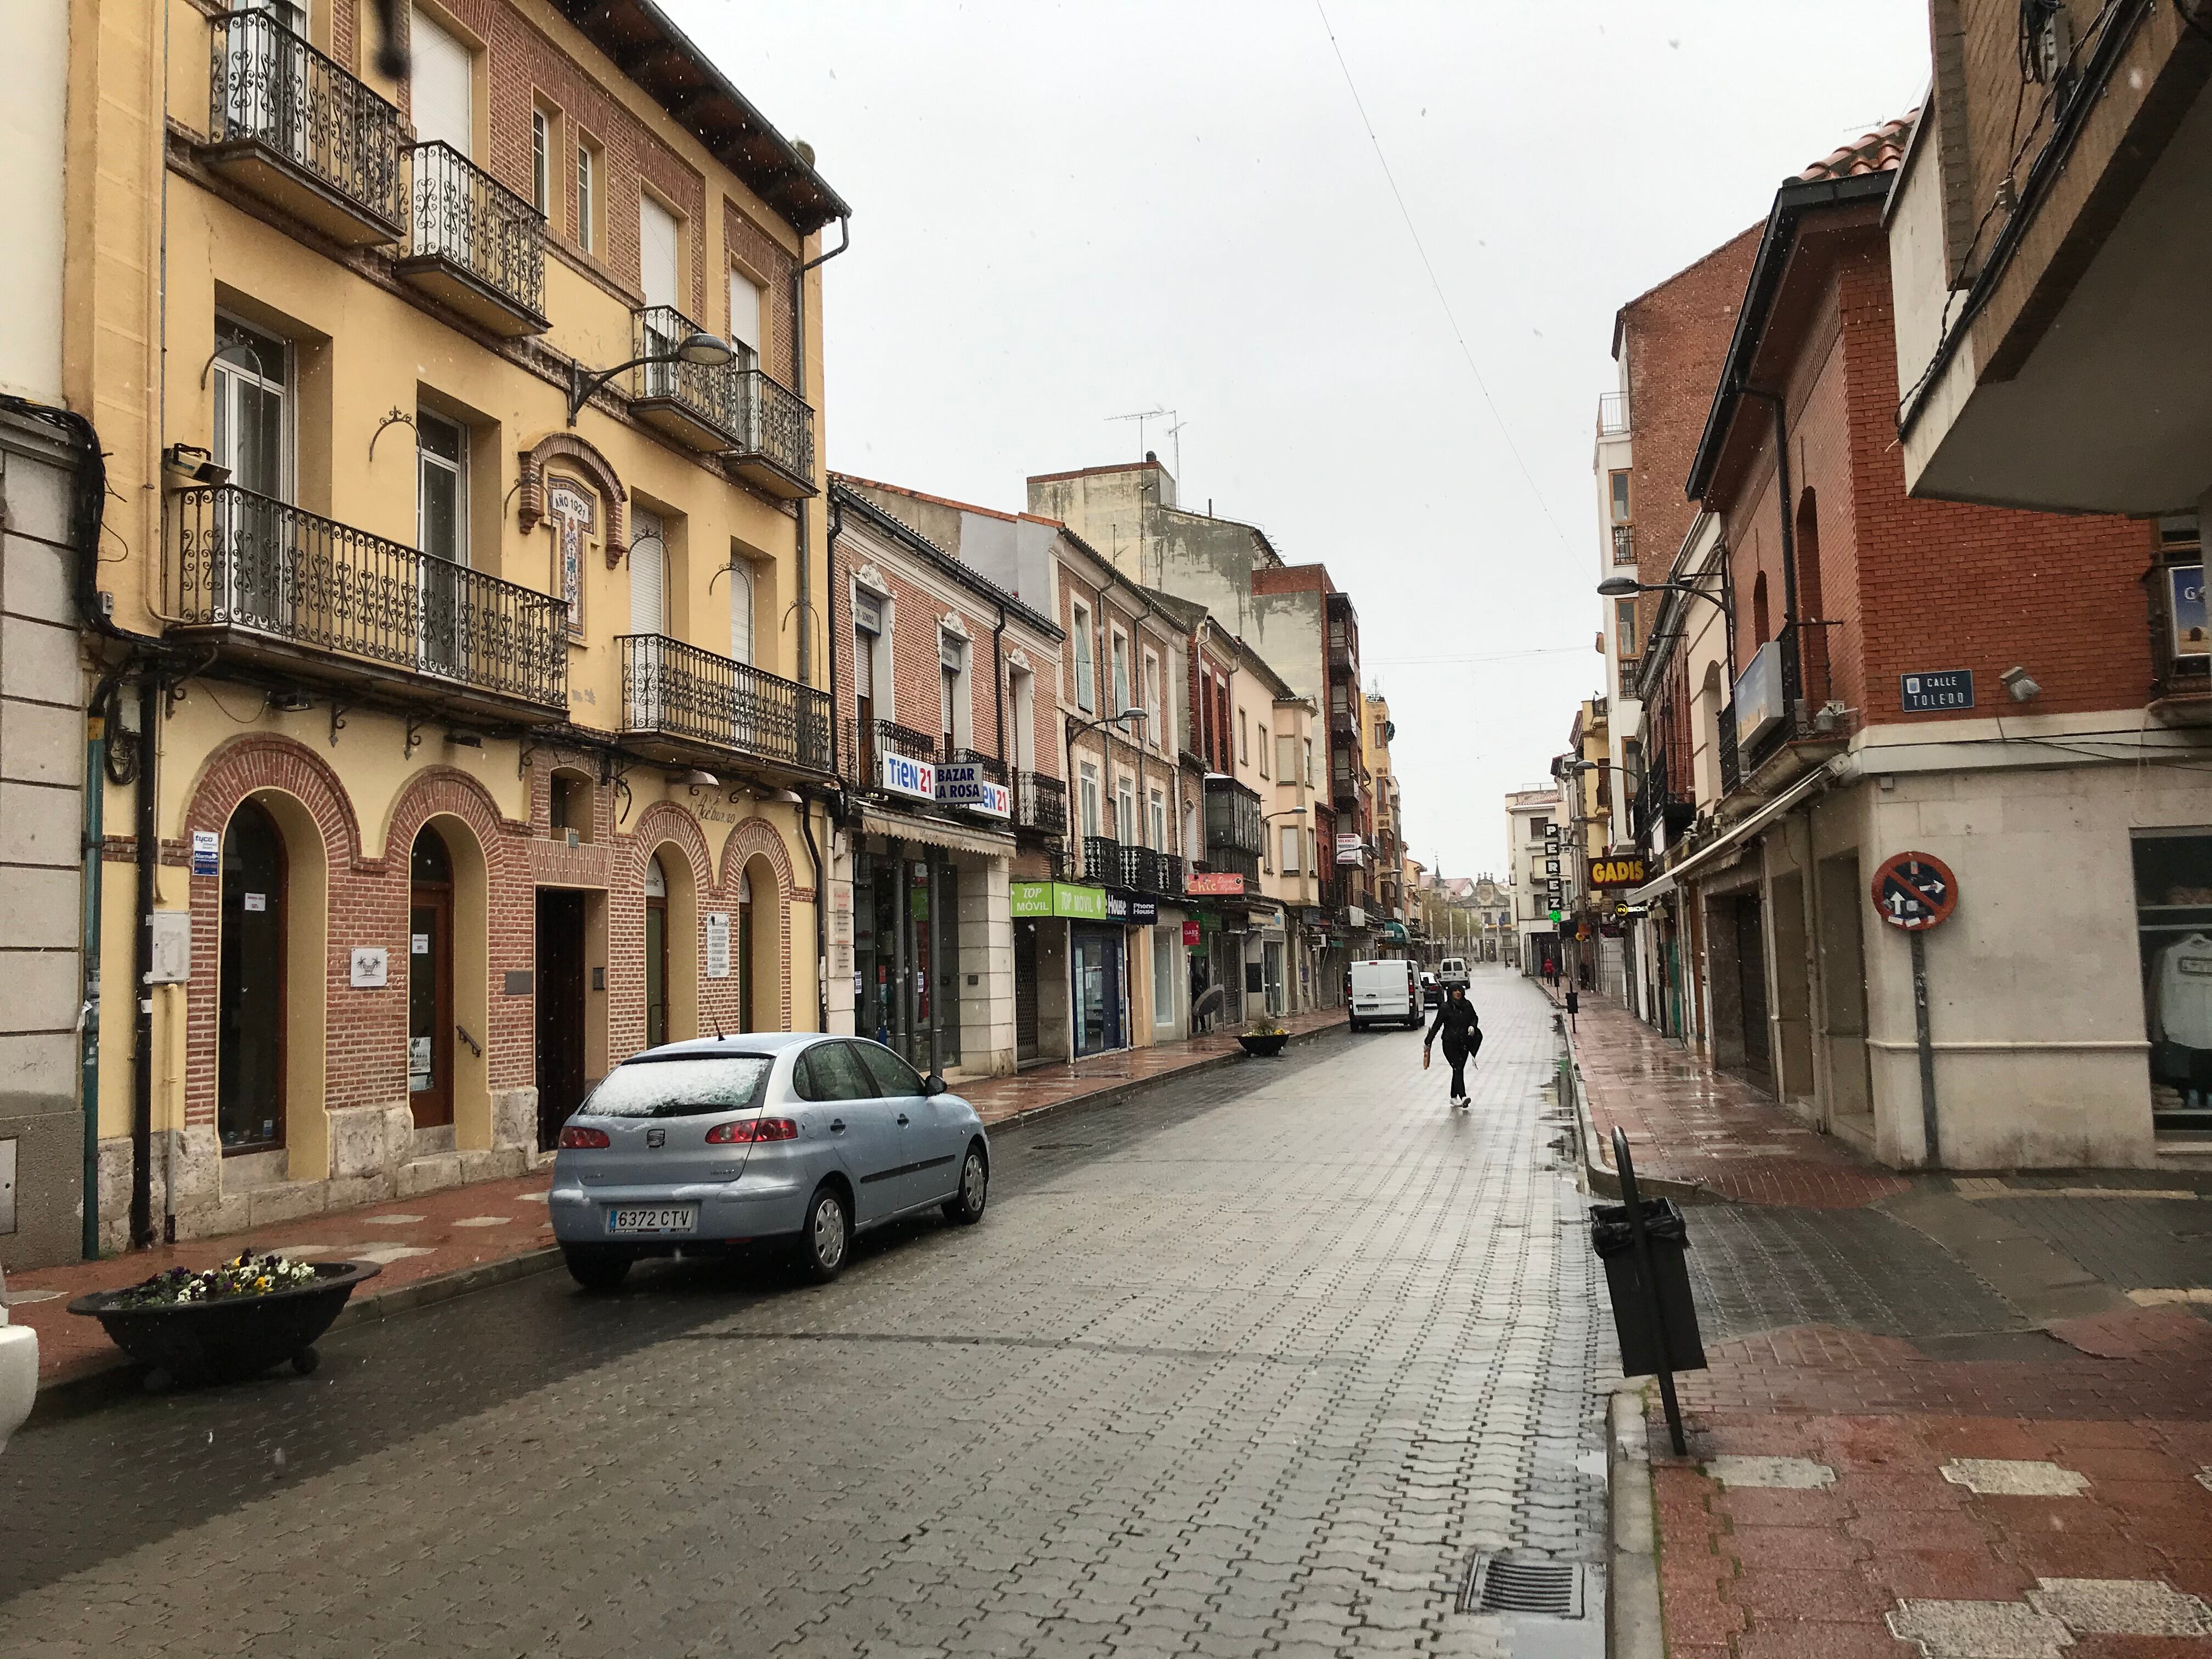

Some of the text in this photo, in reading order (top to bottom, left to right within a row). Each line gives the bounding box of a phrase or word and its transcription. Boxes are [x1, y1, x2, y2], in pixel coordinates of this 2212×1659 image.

[555, 493, 585, 519] AÑO 1921
[1927, 676, 1958, 687] CALLE
[1912, 692, 1964, 706] TOLEDO
[919, 768, 932, 794] 21
[937, 768, 975, 782] BAZAR
[935, 784, 980, 799] LA ROSA
[996, 789, 1007, 812] 21
[195, 834, 213, 843] tyco
[1545, 826, 1560, 908] PEREZ
[1593, 860, 1644, 884] GADIS
[1023, 887, 1042, 899] TOP
[1188, 879, 1217, 893] Chic
[1016, 900, 1049, 912] MÓVIL
[1061, 891, 1072, 910] TOP
[1074, 893, 1093, 913] MÓVIL
[1108, 894, 1126, 916] House
[618, 1210, 690, 1227] 6372 CTV
